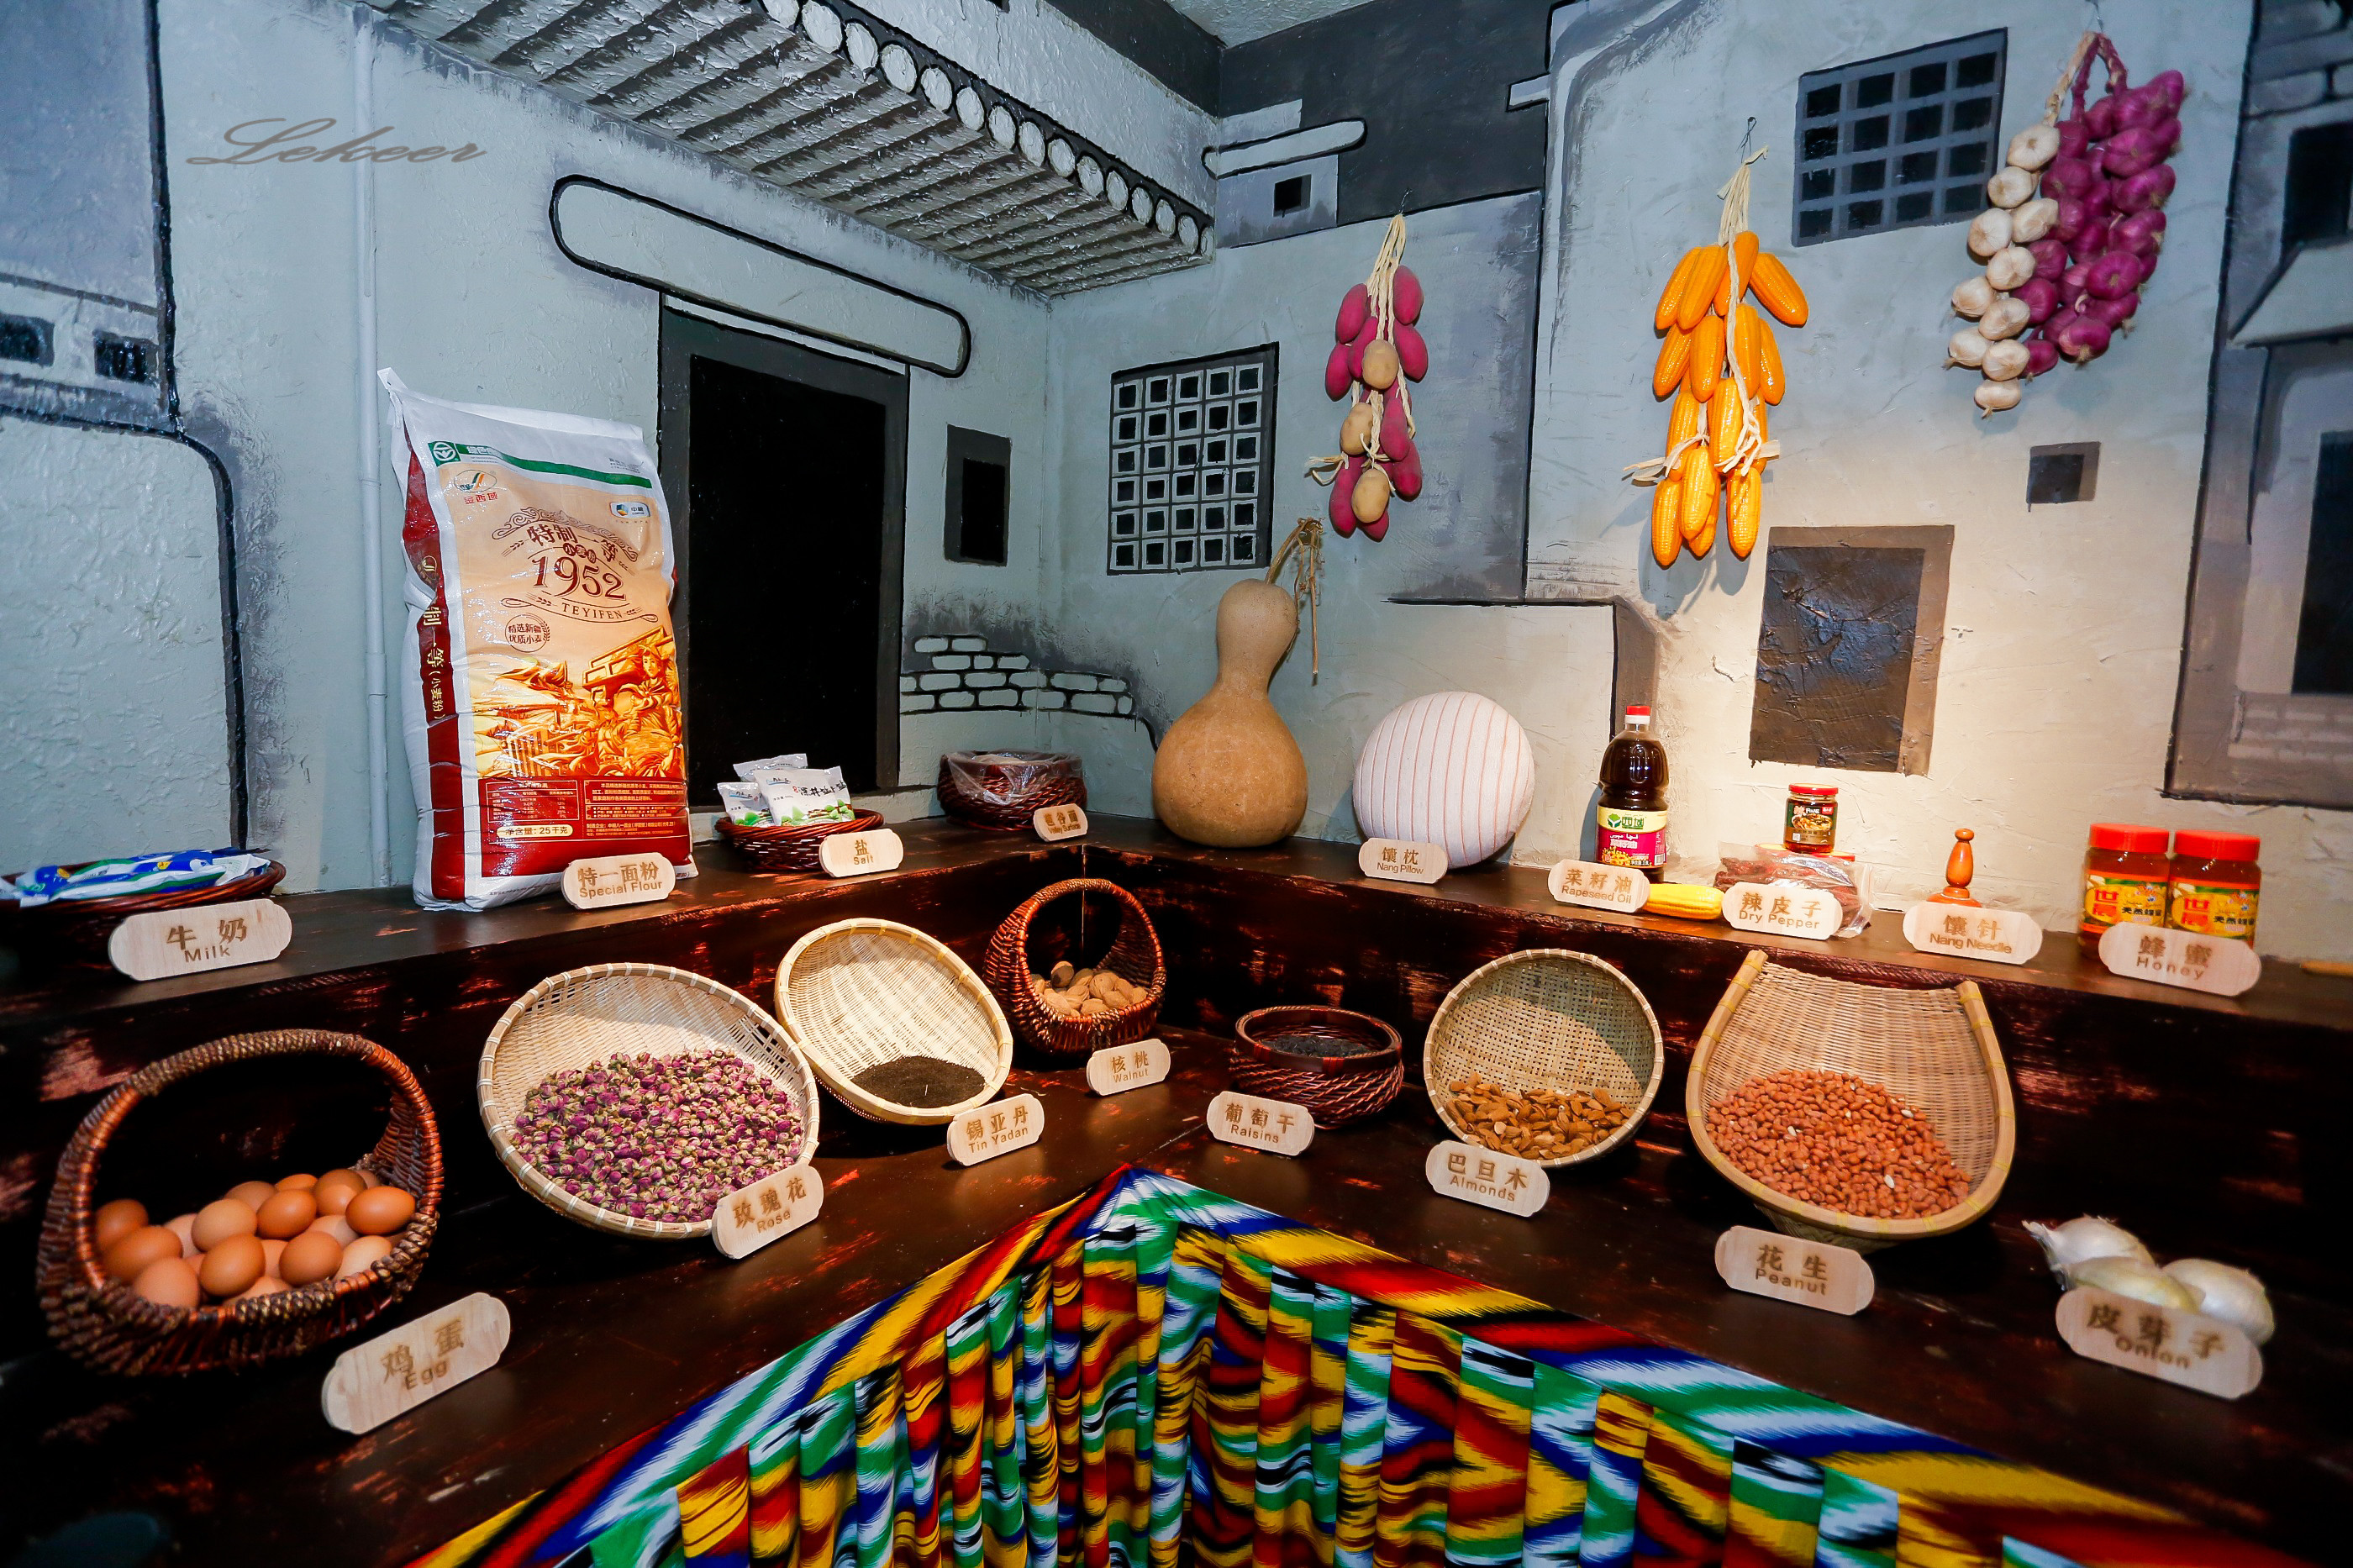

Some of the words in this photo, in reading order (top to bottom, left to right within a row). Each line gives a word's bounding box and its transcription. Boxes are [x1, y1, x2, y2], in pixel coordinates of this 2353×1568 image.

[531, 555, 627, 601] 1952
[561, 602, 624, 619] TEYIFEN
[508, 624, 542, 634] 精选新疆
[508, 634, 543, 645] 优质小麦
[854, 839, 869, 855] 盐
[853, 855, 874, 866] Salt
[1377, 862, 1399, 874] Nang
[1400, 865, 1424, 875] Pillow
[576, 861, 660, 887] 特一面粉
[1565, 868, 1633, 894] 菜籽油
[579, 885, 628, 900] Special
[631, 881, 663, 892] Flour
[1561, 885, 1614, 902] Rapeseed
[1617, 893, 1632, 904] Oil
[1741, 892, 1822, 918] 辣皮子
[1739, 910, 1763, 923] Dry
[1767, 913, 1820, 929] Pepper
[166, 918, 248, 950] 牛奶
[1929, 933, 1964, 950] Nang
[1966, 938, 2013, 955] Needle
[183, 944, 231, 963] Milk
[2138, 935, 2213, 968] 蜂蜜
[2136, 955, 2204, 981] Honey
[1111, 1050, 1150, 1074] 核桃
[1113, 1068, 1149, 1083] Walnut
[966, 1105, 1029, 1141] 锡亚丹
[1224, 1102, 1295, 1134] 葡萄干
[968, 1141, 988, 1154] Tin
[992, 1127, 1029, 1145] Yadan
[1230, 1123, 1280, 1144] Raisins
[1447, 1152, 1528, 1191] 巴旦木
[1450, 1175, 1516, 1202] Almonds
[733, 1177, 807, 1229] 玫瑰花
[756, 1209, 792, 1234] Rose
[1756, 1244, 1829, 1281] 花生
[1755, 1267, 1828, 1296] Peanut
[380, 1318, 466, 1385] 鸡蛋
[2114, 1336, 2190, 1370] Onion
[404, 1359, 449, 1391] Egg
